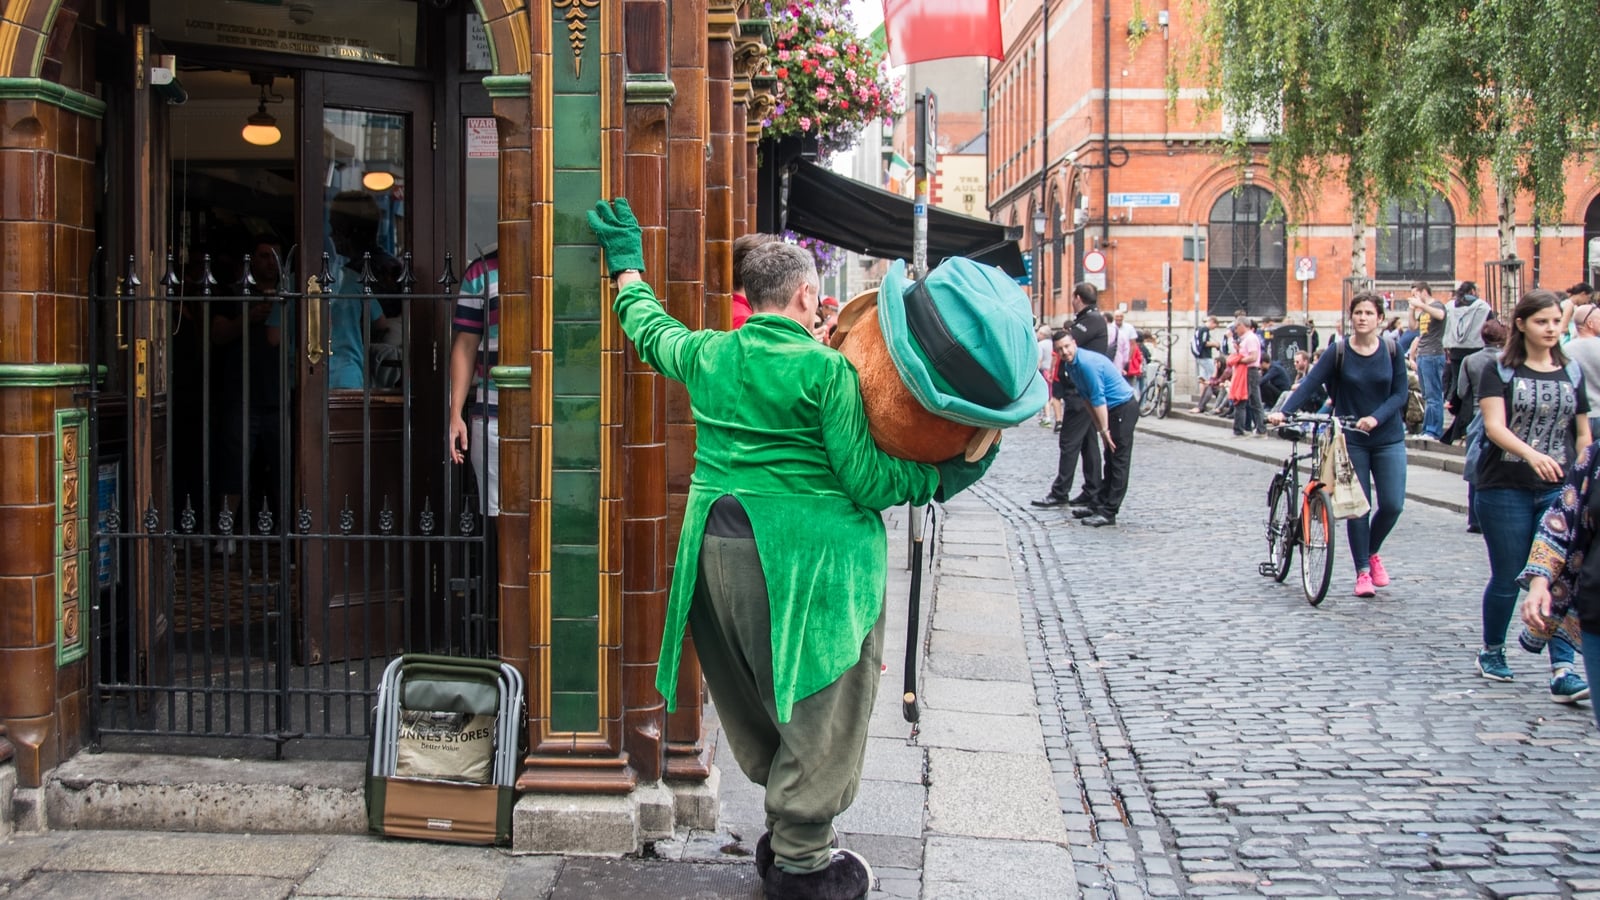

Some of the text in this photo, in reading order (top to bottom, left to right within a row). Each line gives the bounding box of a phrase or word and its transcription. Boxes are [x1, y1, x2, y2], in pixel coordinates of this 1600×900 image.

[340, 48, 361, 57] DAYS
[444, 727, 489, 743] STORES
[421, 742, 460, 751] Better Value
